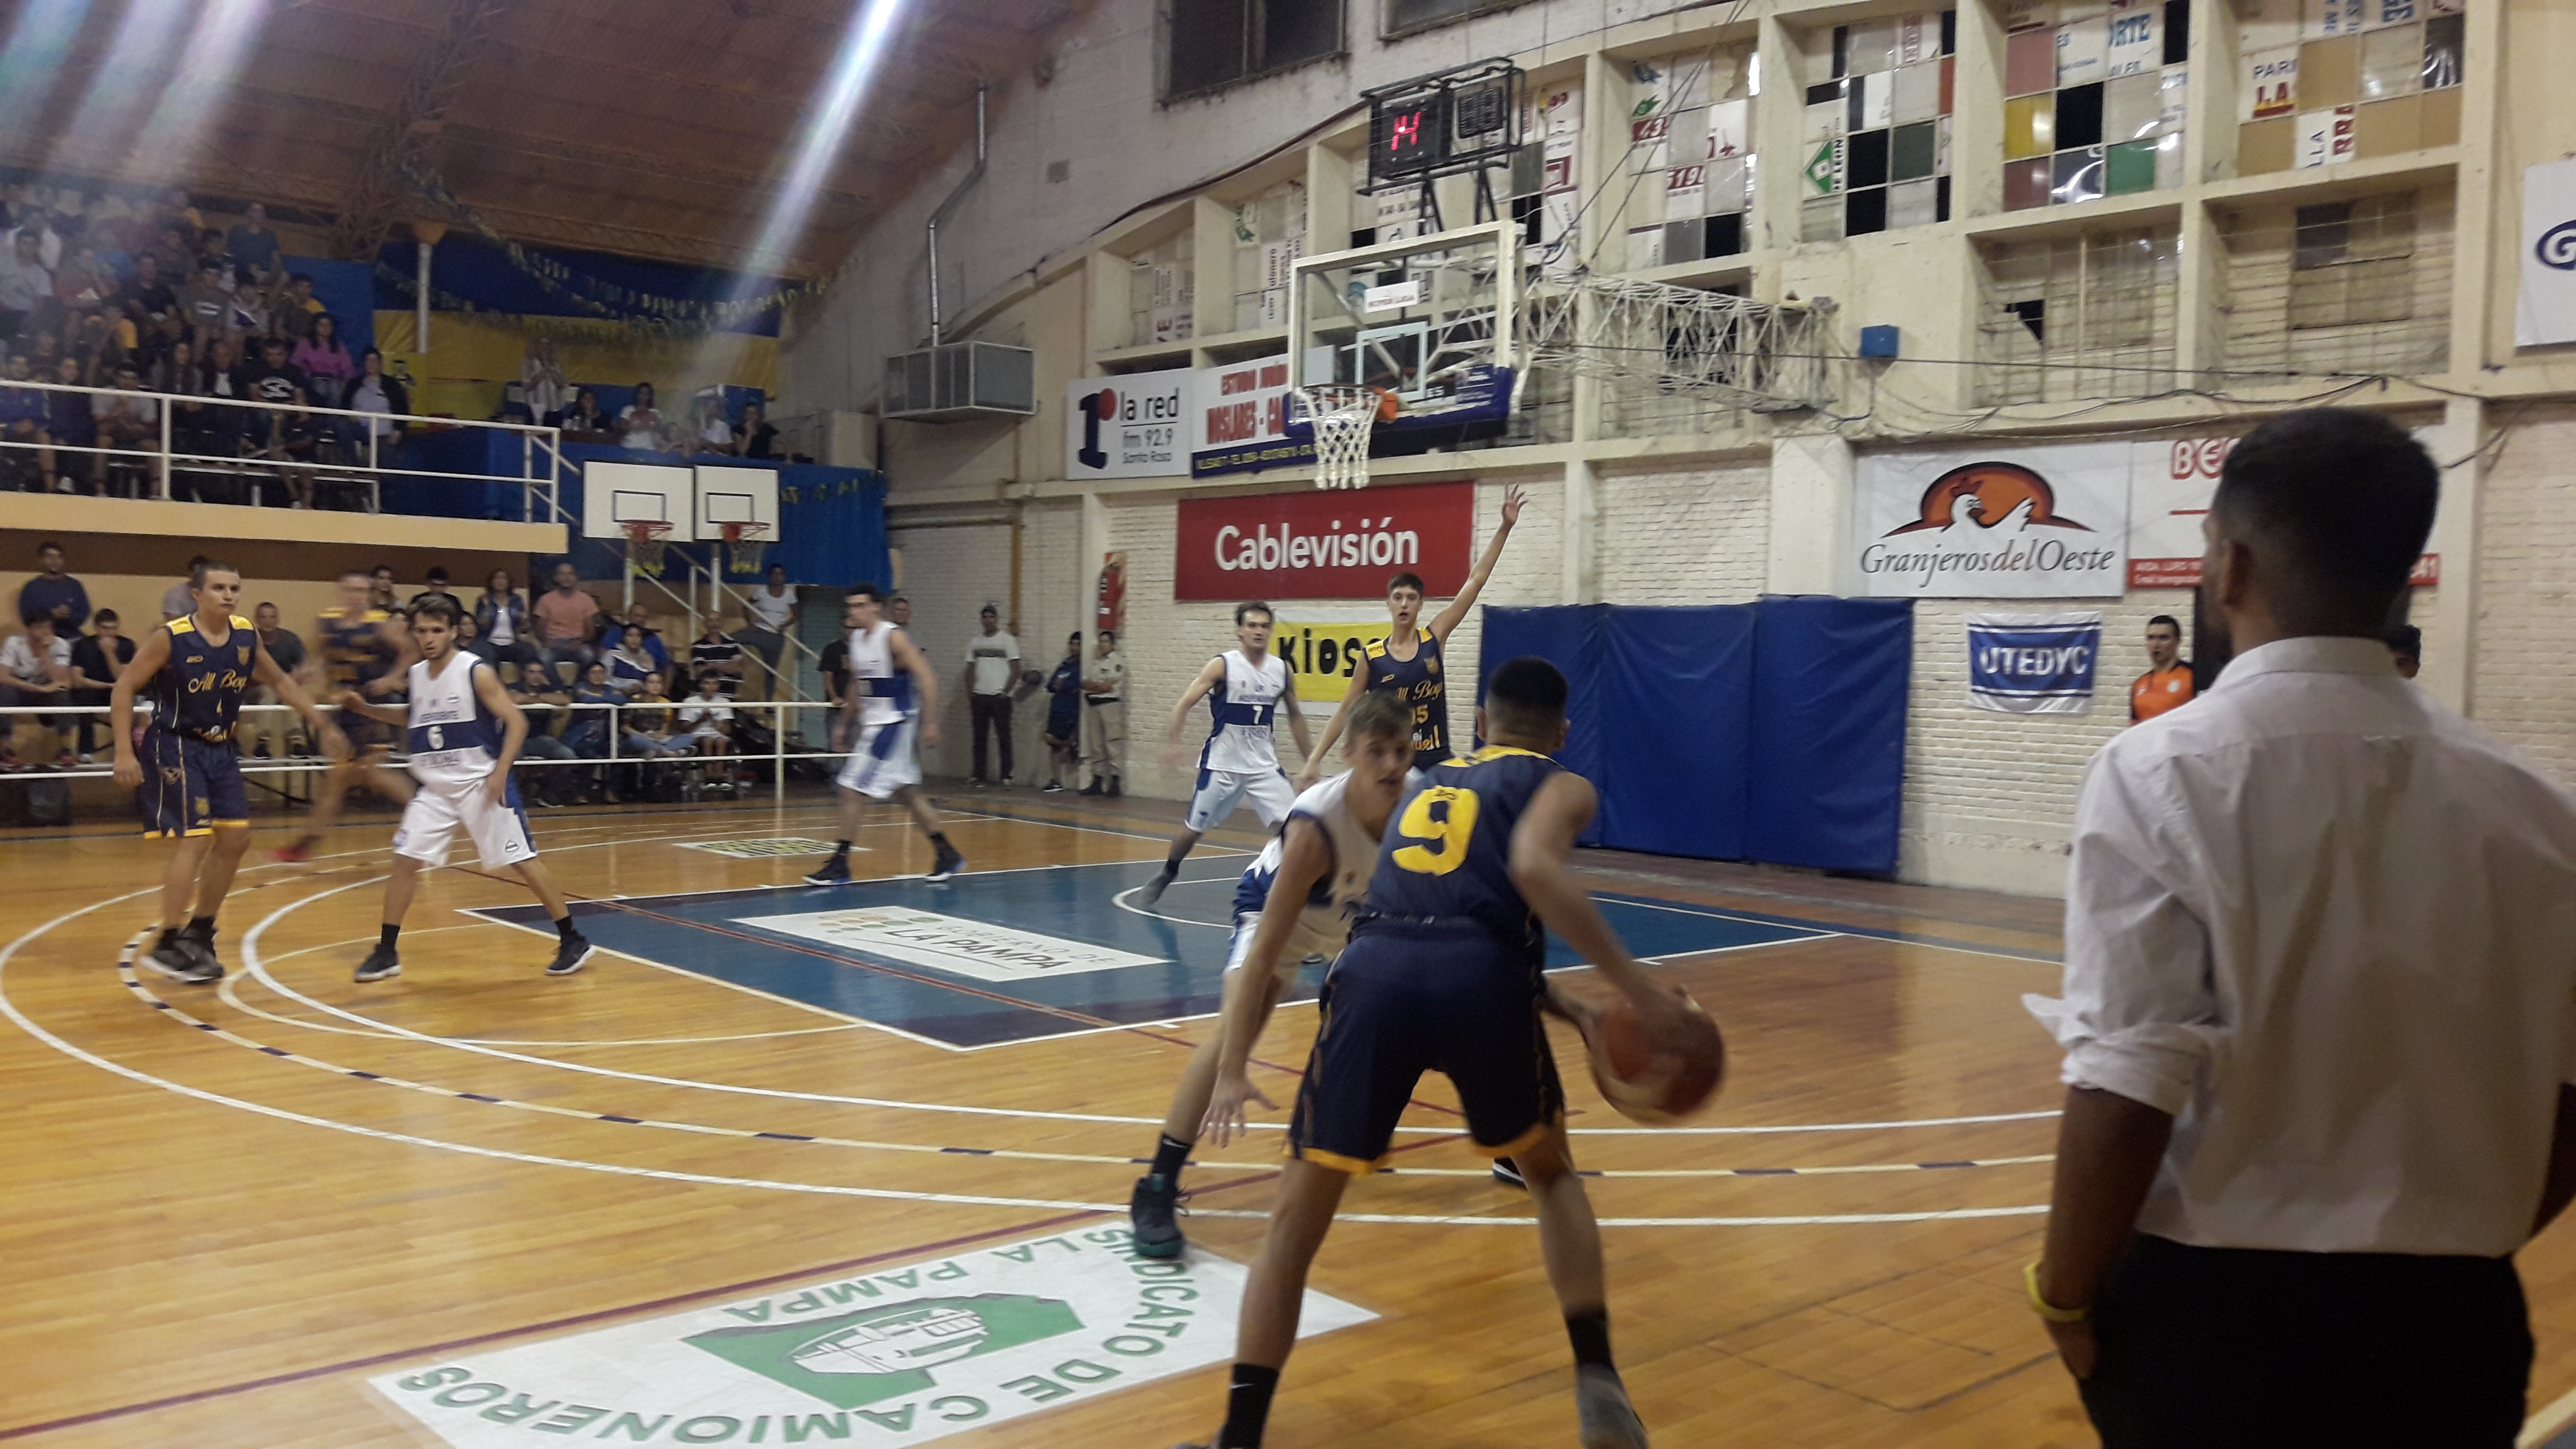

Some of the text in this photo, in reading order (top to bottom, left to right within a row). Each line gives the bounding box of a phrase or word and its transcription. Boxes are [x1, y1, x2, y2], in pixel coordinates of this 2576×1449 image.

[1120, 387, 1179, 421] la red
[2170, 437, 2242, 480] BE
[1214, 517, 1419, 570] Cablevisión
[1277, 627, 1383, 678] Kios
[1979, 646, 2090, 676] UTEDYC
[220, 668, 248, 694] Boy
[1412, 680, 1444, 701] Boy
[1252, 705, 1264, 724] 7
[427, 725, 444, 749] 6
[1392, 785, 1481, 876] 9
[883, 929, 1071, 970] LA PAMPA
[723, 1238, 1083, 1323] LA PAMPA
[1000, 1359, 1124, 1403] DE
[397, 1367, 989, 1444] CAMIONEROS
